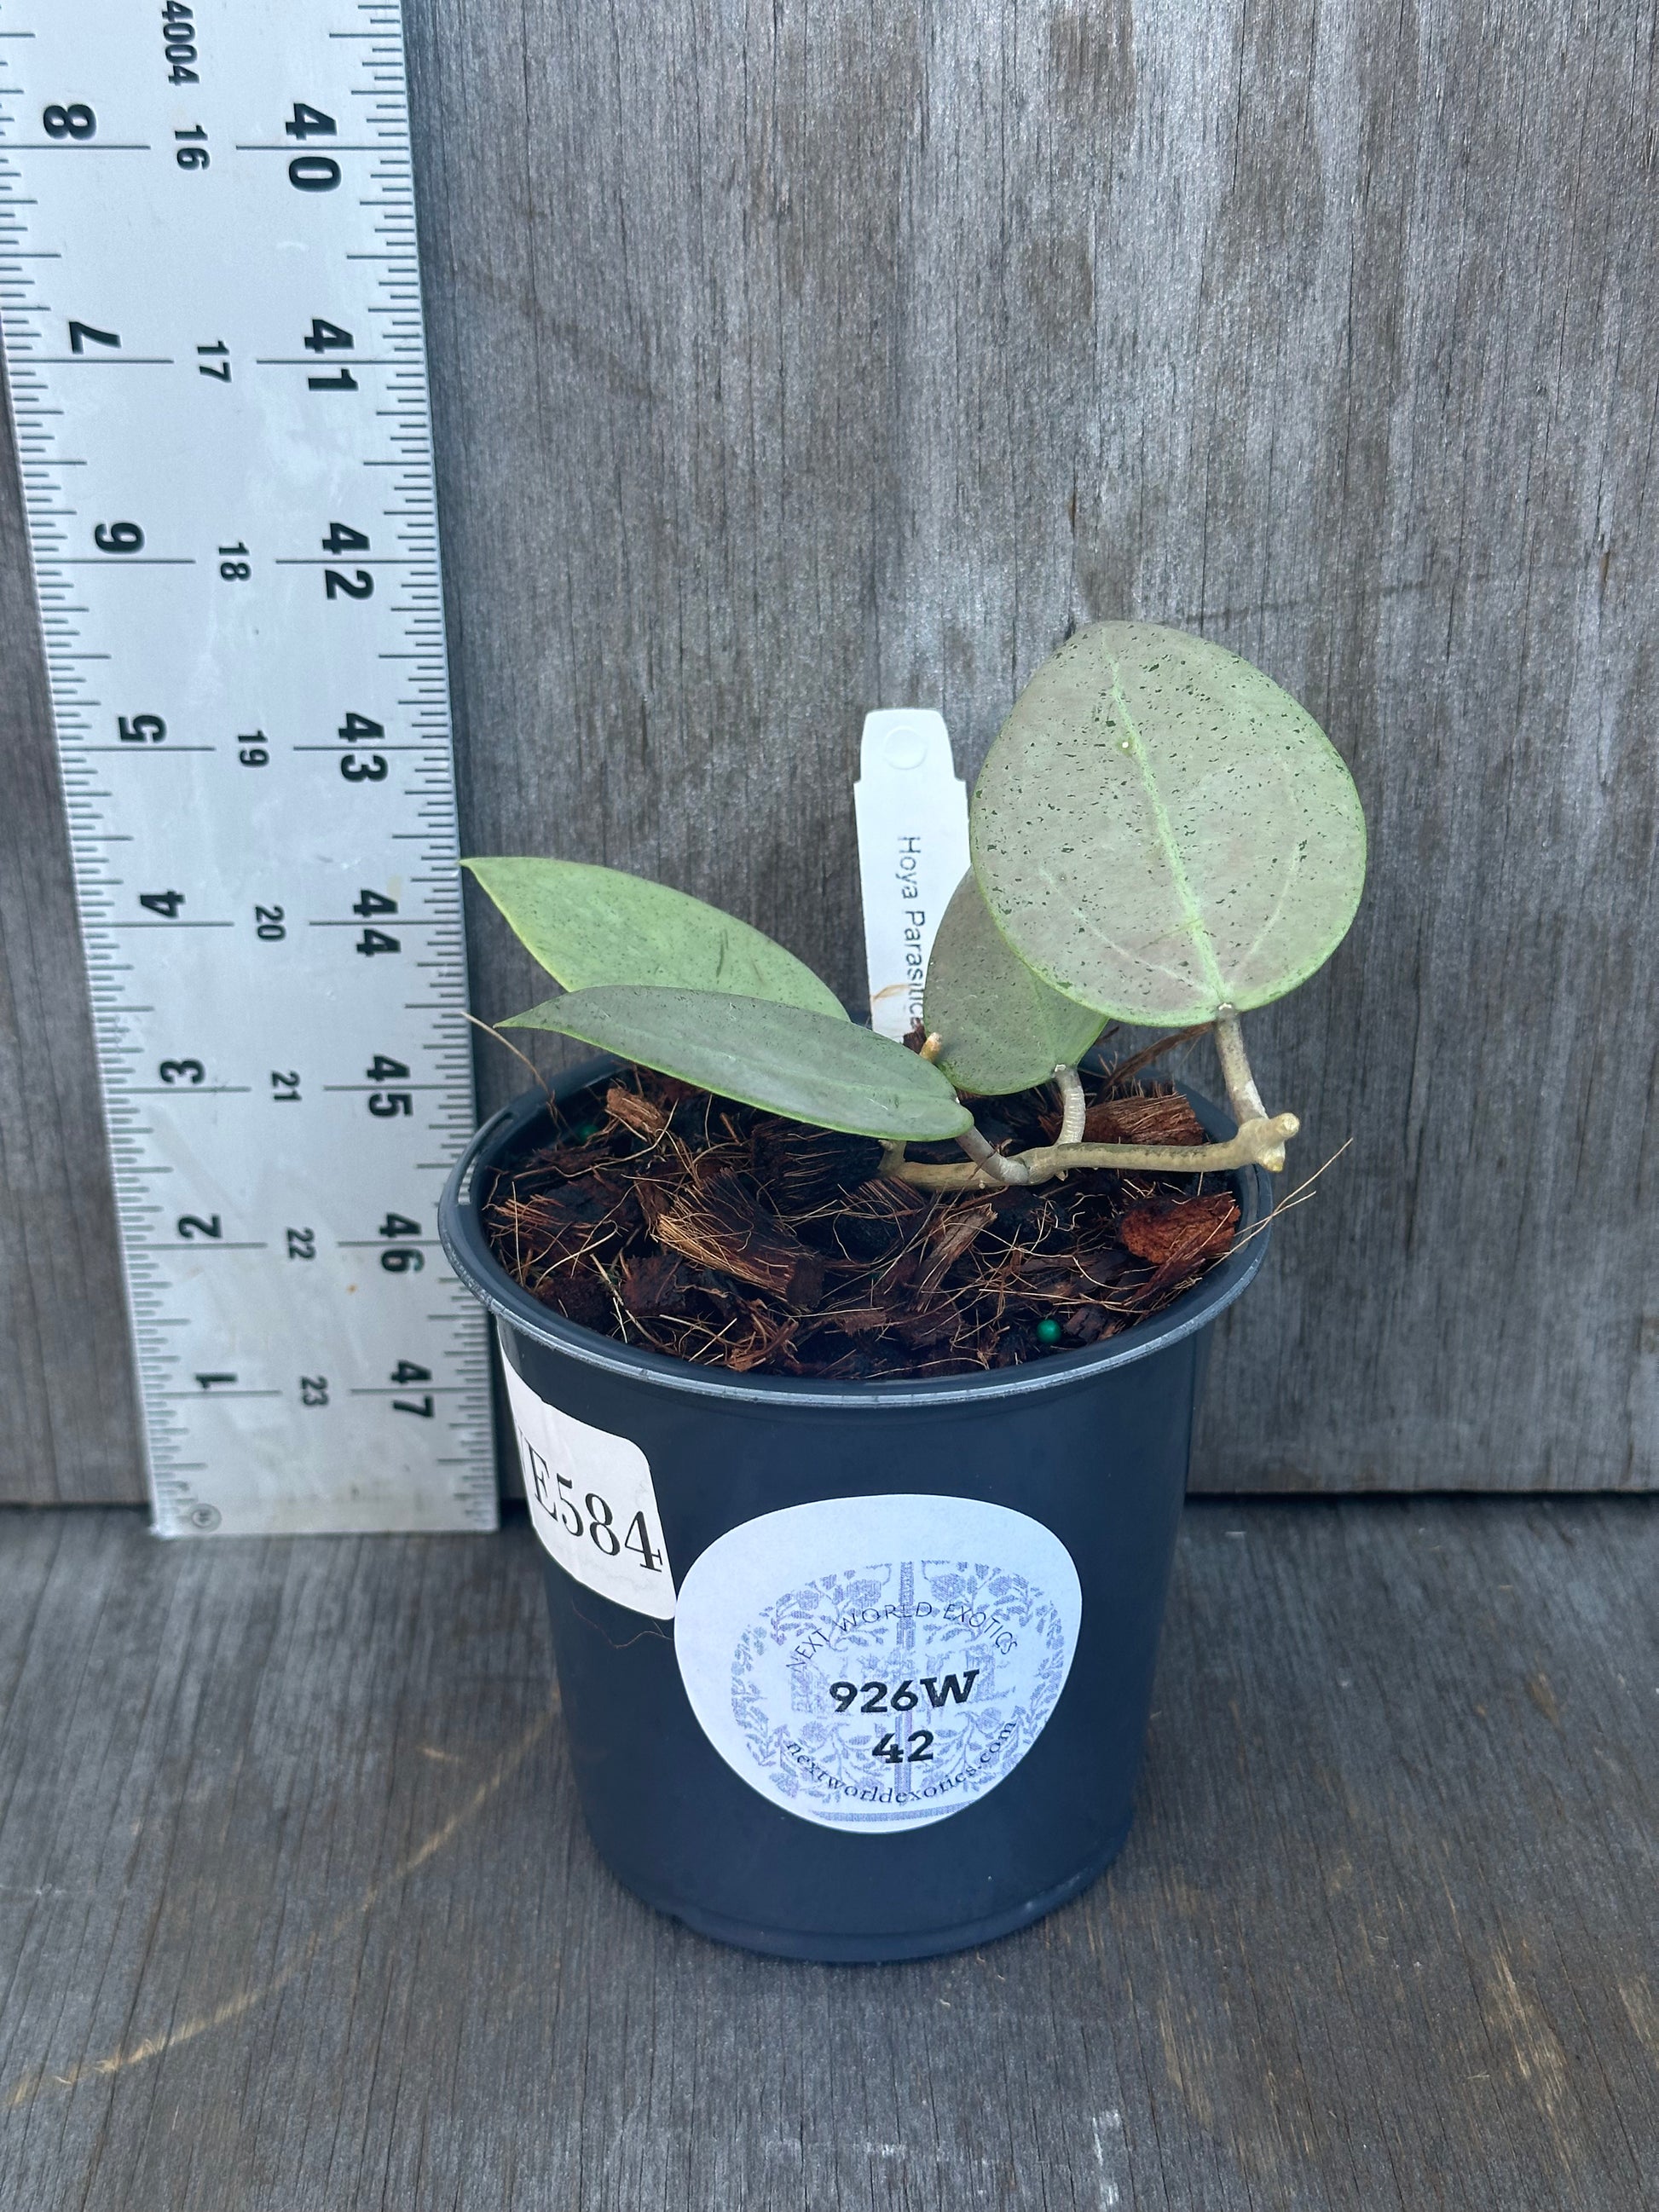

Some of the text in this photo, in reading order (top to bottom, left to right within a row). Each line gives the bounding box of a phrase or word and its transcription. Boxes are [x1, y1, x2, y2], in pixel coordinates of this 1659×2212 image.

[43, 103, 96, 140] 8
[174, 124, 210, 170] 16
[285, 102, 341, 192] 40
[68, 321, 120, 354] 7
[303, 318, 358, 391] 41
[196, 340, 231, 383] 17
[94, 522, 144, 554] 6
[218, 541, 251, 581] 18
[321, 522, 373, 600] 42
[118, 714, 166, 743] 5
[237, 730, 269, 767] 19
[338, 712, 388, 783] 43
[895, 835, 922, 900] Hoya
[139, 890, 185, 919] 4
[255, 905, 286, 942] 20
[352, 889, 401, 957] 44
[159, 1060, 205, 1084] 3
[271, 1071, 302, 1101] 21
[366, 1055, 413, 1118] 45
[177, 1215, 222, 1239] 2
[286, 1228, 315, 1260] 22
[379, 1213, 425, 1273] 46
[194, 1373, 237, 1390] 1
[300, 1377, 329, 1406] 23
[390, 1360, 435, 1419] 47
[786, 1601, 1018, 1672] NEXT WORLD EXOTICS
[829, 1668, 980, 1714] 926W
[786, 1721, 1017, 1805] nextworldexotics.com
[871, 1729, 934, 1764] 42
